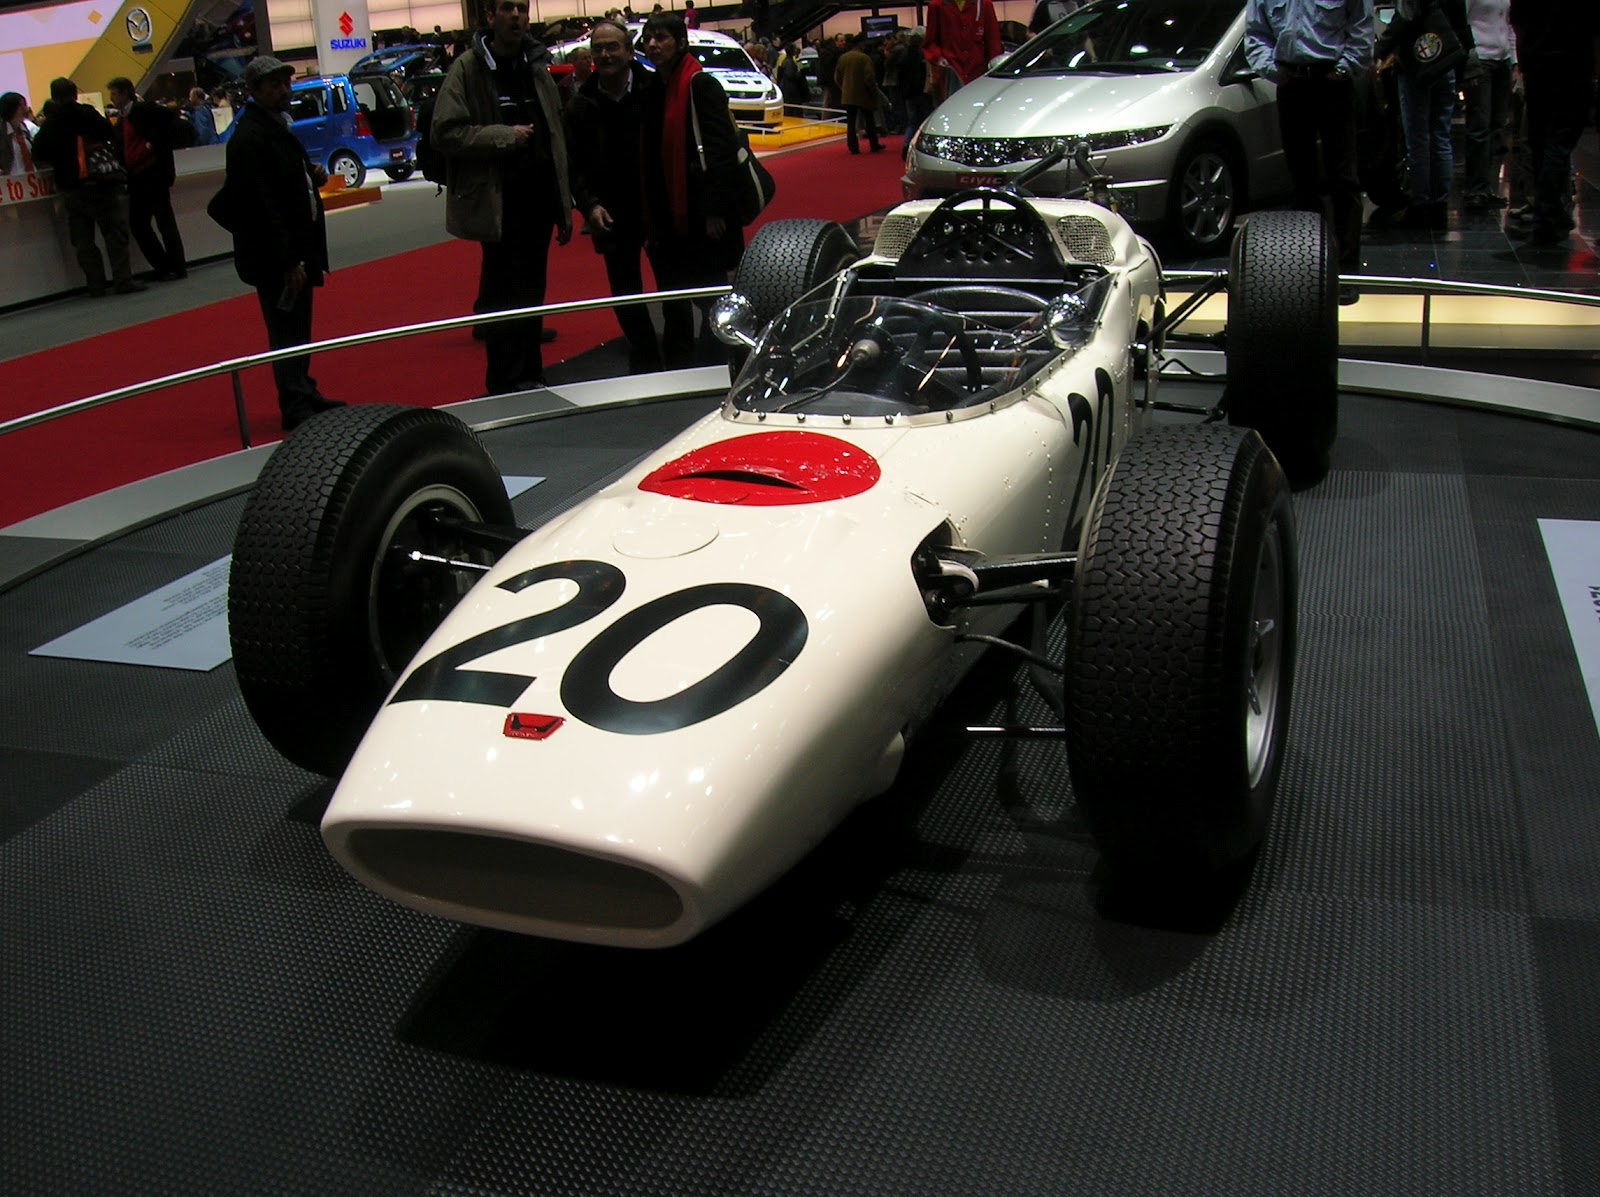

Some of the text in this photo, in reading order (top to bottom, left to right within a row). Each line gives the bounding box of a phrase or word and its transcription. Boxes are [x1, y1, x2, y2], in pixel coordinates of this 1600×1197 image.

[330, 38, 367, 50] SUZUKI
[959, 175, 1003, 186] CIVIC
[6, 179, 24, 201] to
[386, 559, 809, 736] 20
